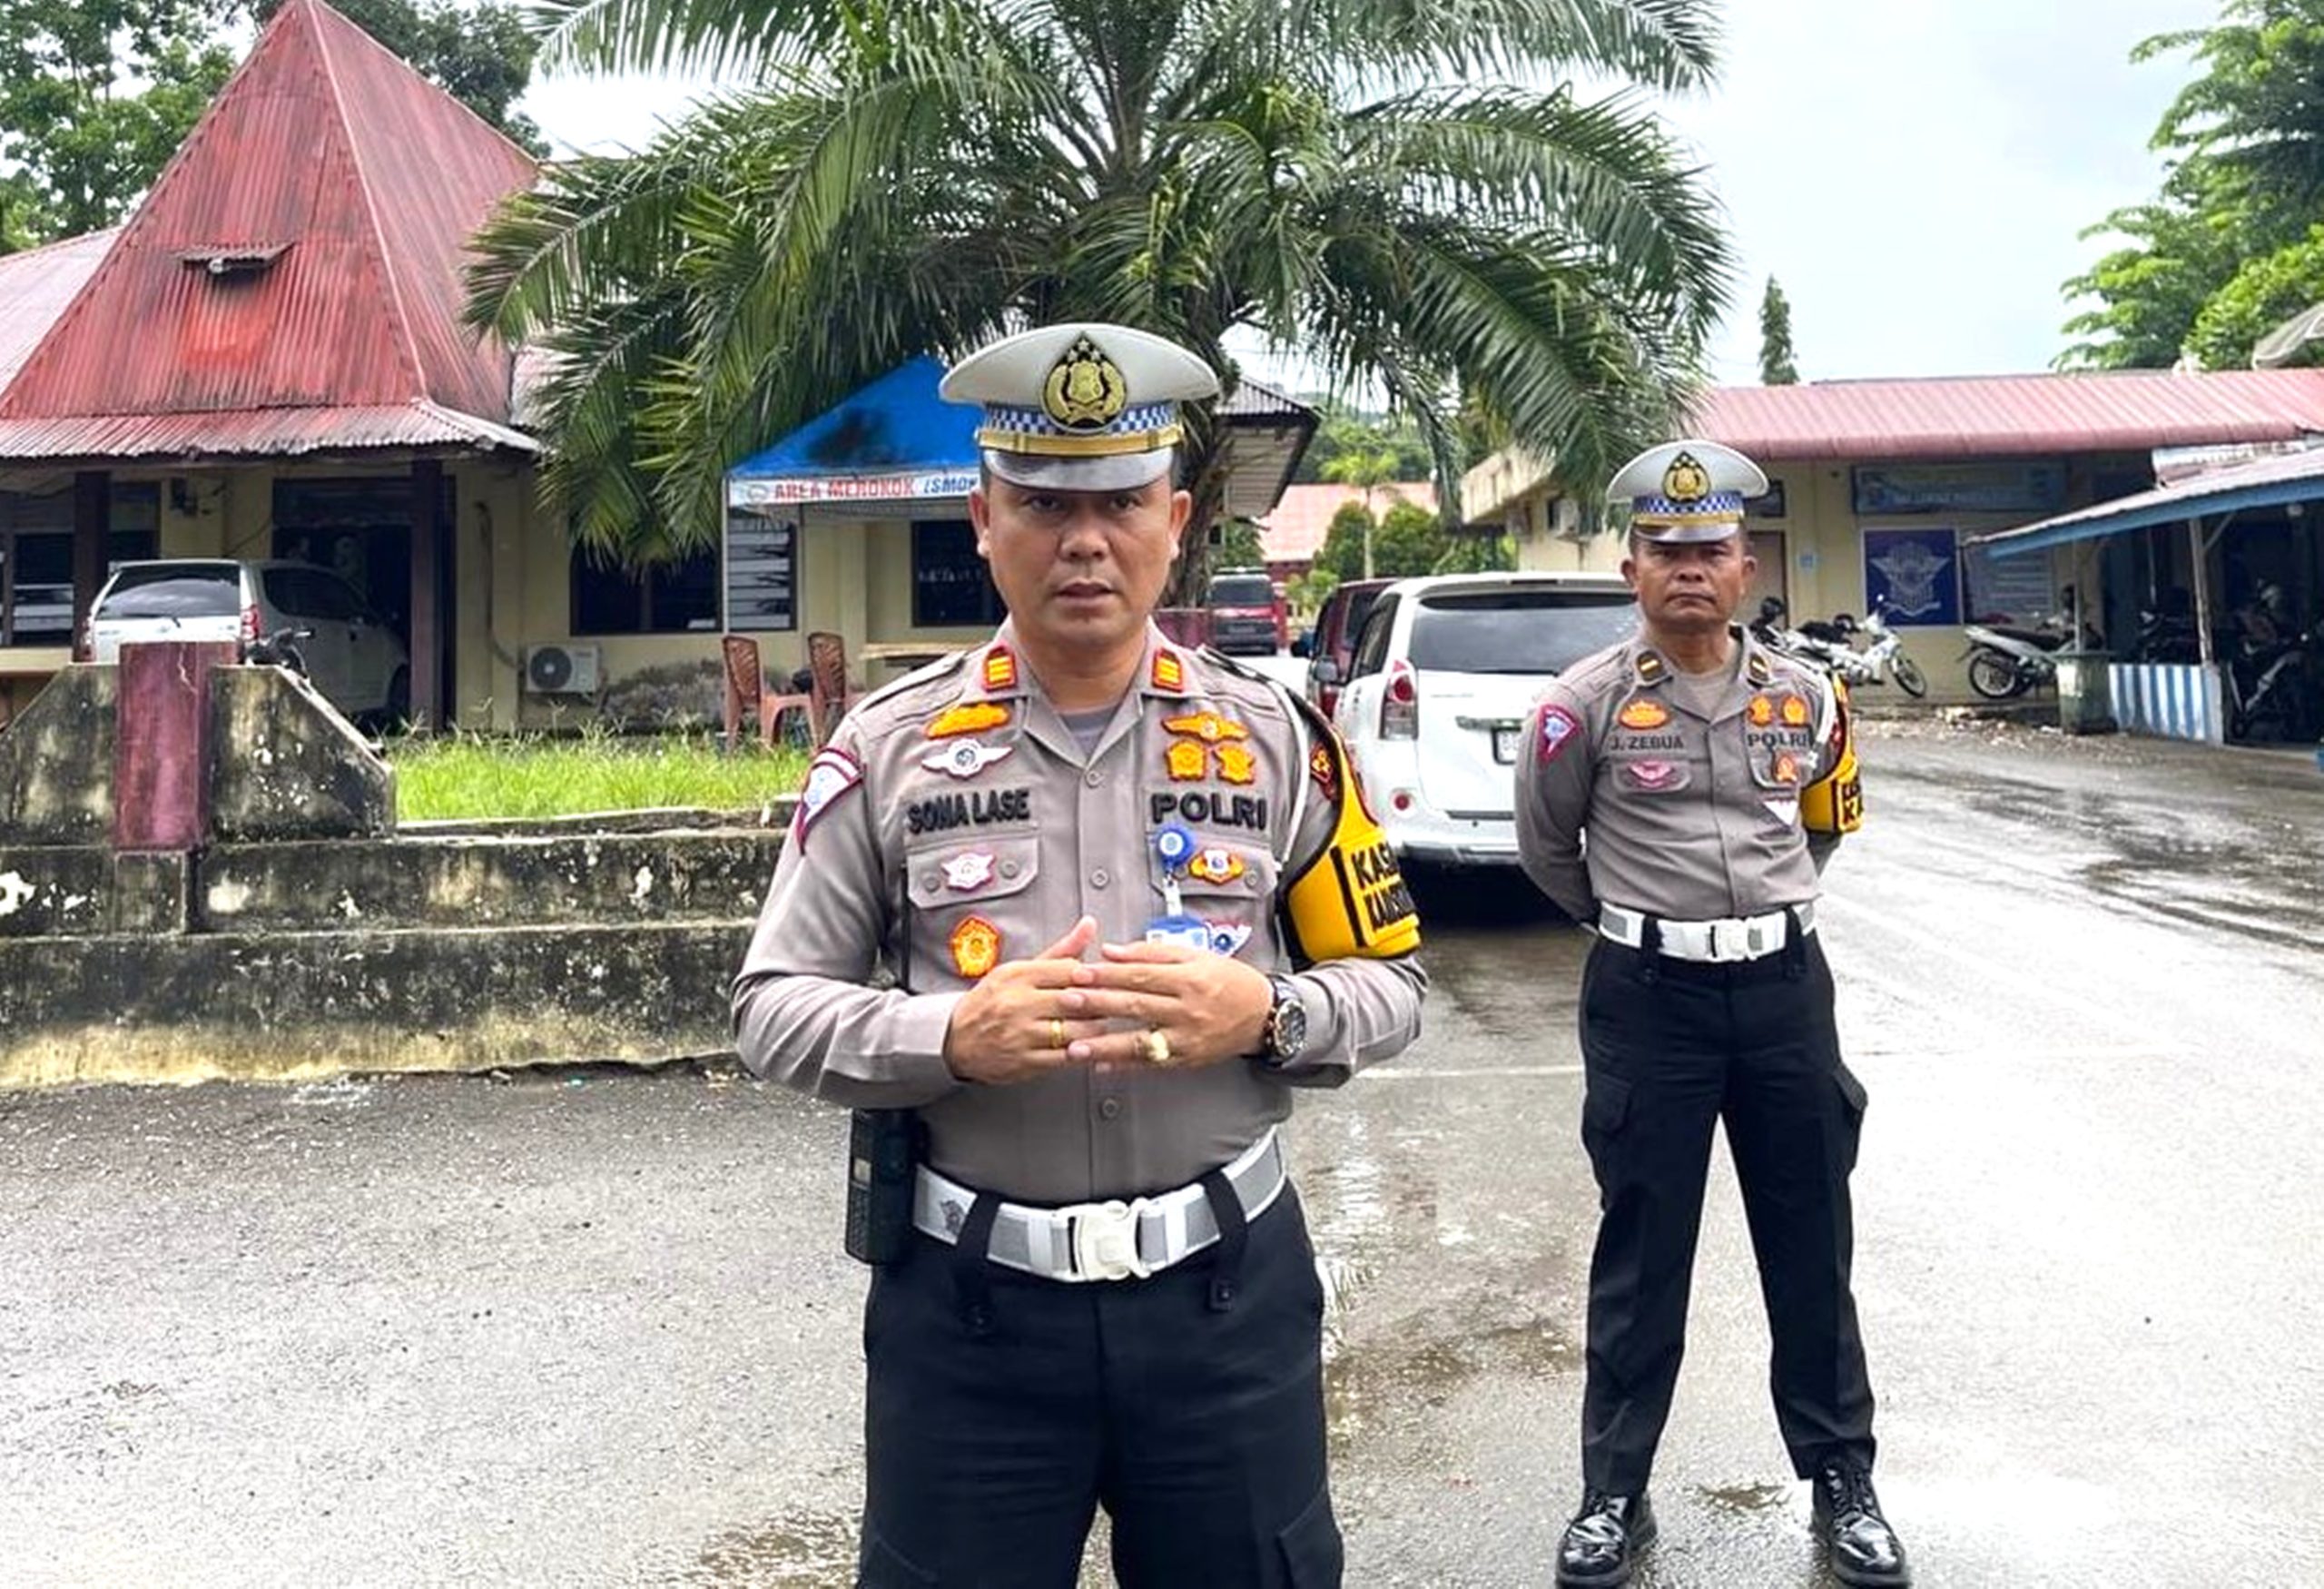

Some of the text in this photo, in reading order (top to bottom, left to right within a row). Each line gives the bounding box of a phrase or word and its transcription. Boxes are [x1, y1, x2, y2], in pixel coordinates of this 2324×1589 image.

[1627, 734, 1684, 751] ZEBUA
[1747, 731, 1808, 747] POLRI
[972, 788, 1030, 824] LASE
[1150, 791, 1268, 831] POLRI
